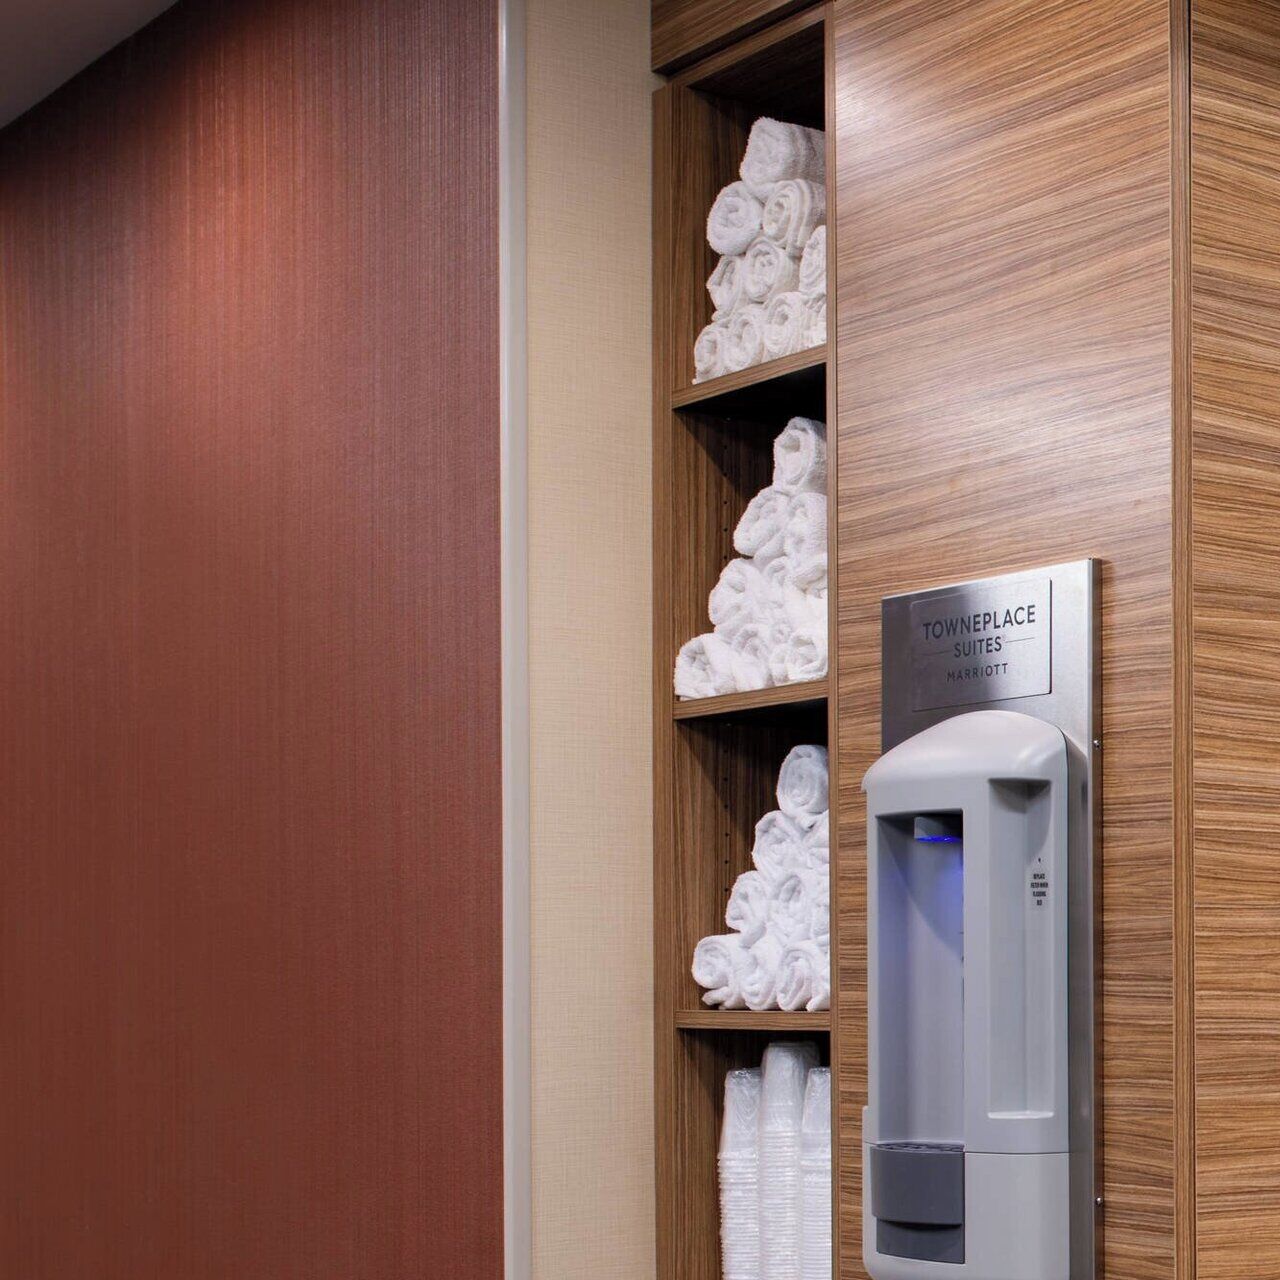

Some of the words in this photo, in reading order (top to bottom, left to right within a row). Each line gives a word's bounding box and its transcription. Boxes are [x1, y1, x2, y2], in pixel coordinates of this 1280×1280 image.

[923, 604, 1036, 640] TOWNEPLACE
[954, 636, 1002, 658] SUITES
[946, 663, 1009, 682] MARRIOTT
